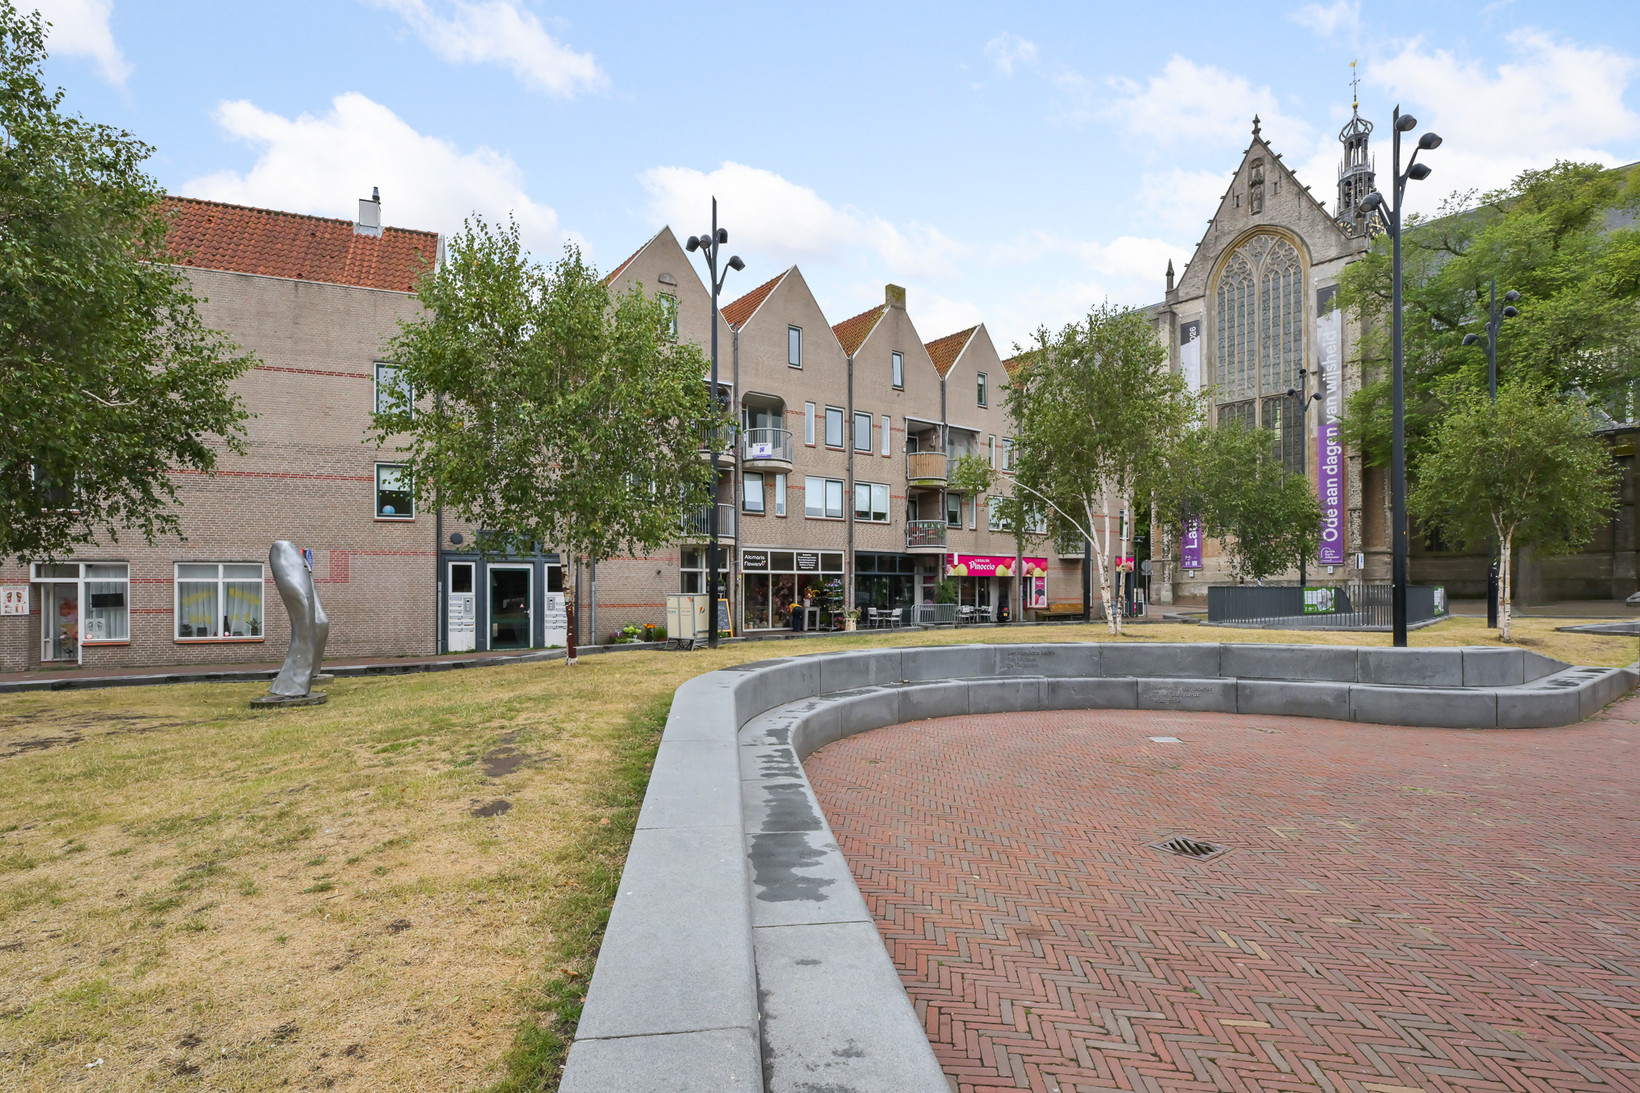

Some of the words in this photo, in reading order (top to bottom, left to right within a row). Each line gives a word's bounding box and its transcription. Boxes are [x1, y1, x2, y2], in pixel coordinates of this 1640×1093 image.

[1322, 330, 1341, 394] wijsheid
[1326, 396, 1337, 425] van
[1322, 427, 1342, 475] dagen
[1326, 478, 1338, 506] aan
[1322, 508, 1338, 542] Ode
[968, 560, 996, 571] Pinoccio
